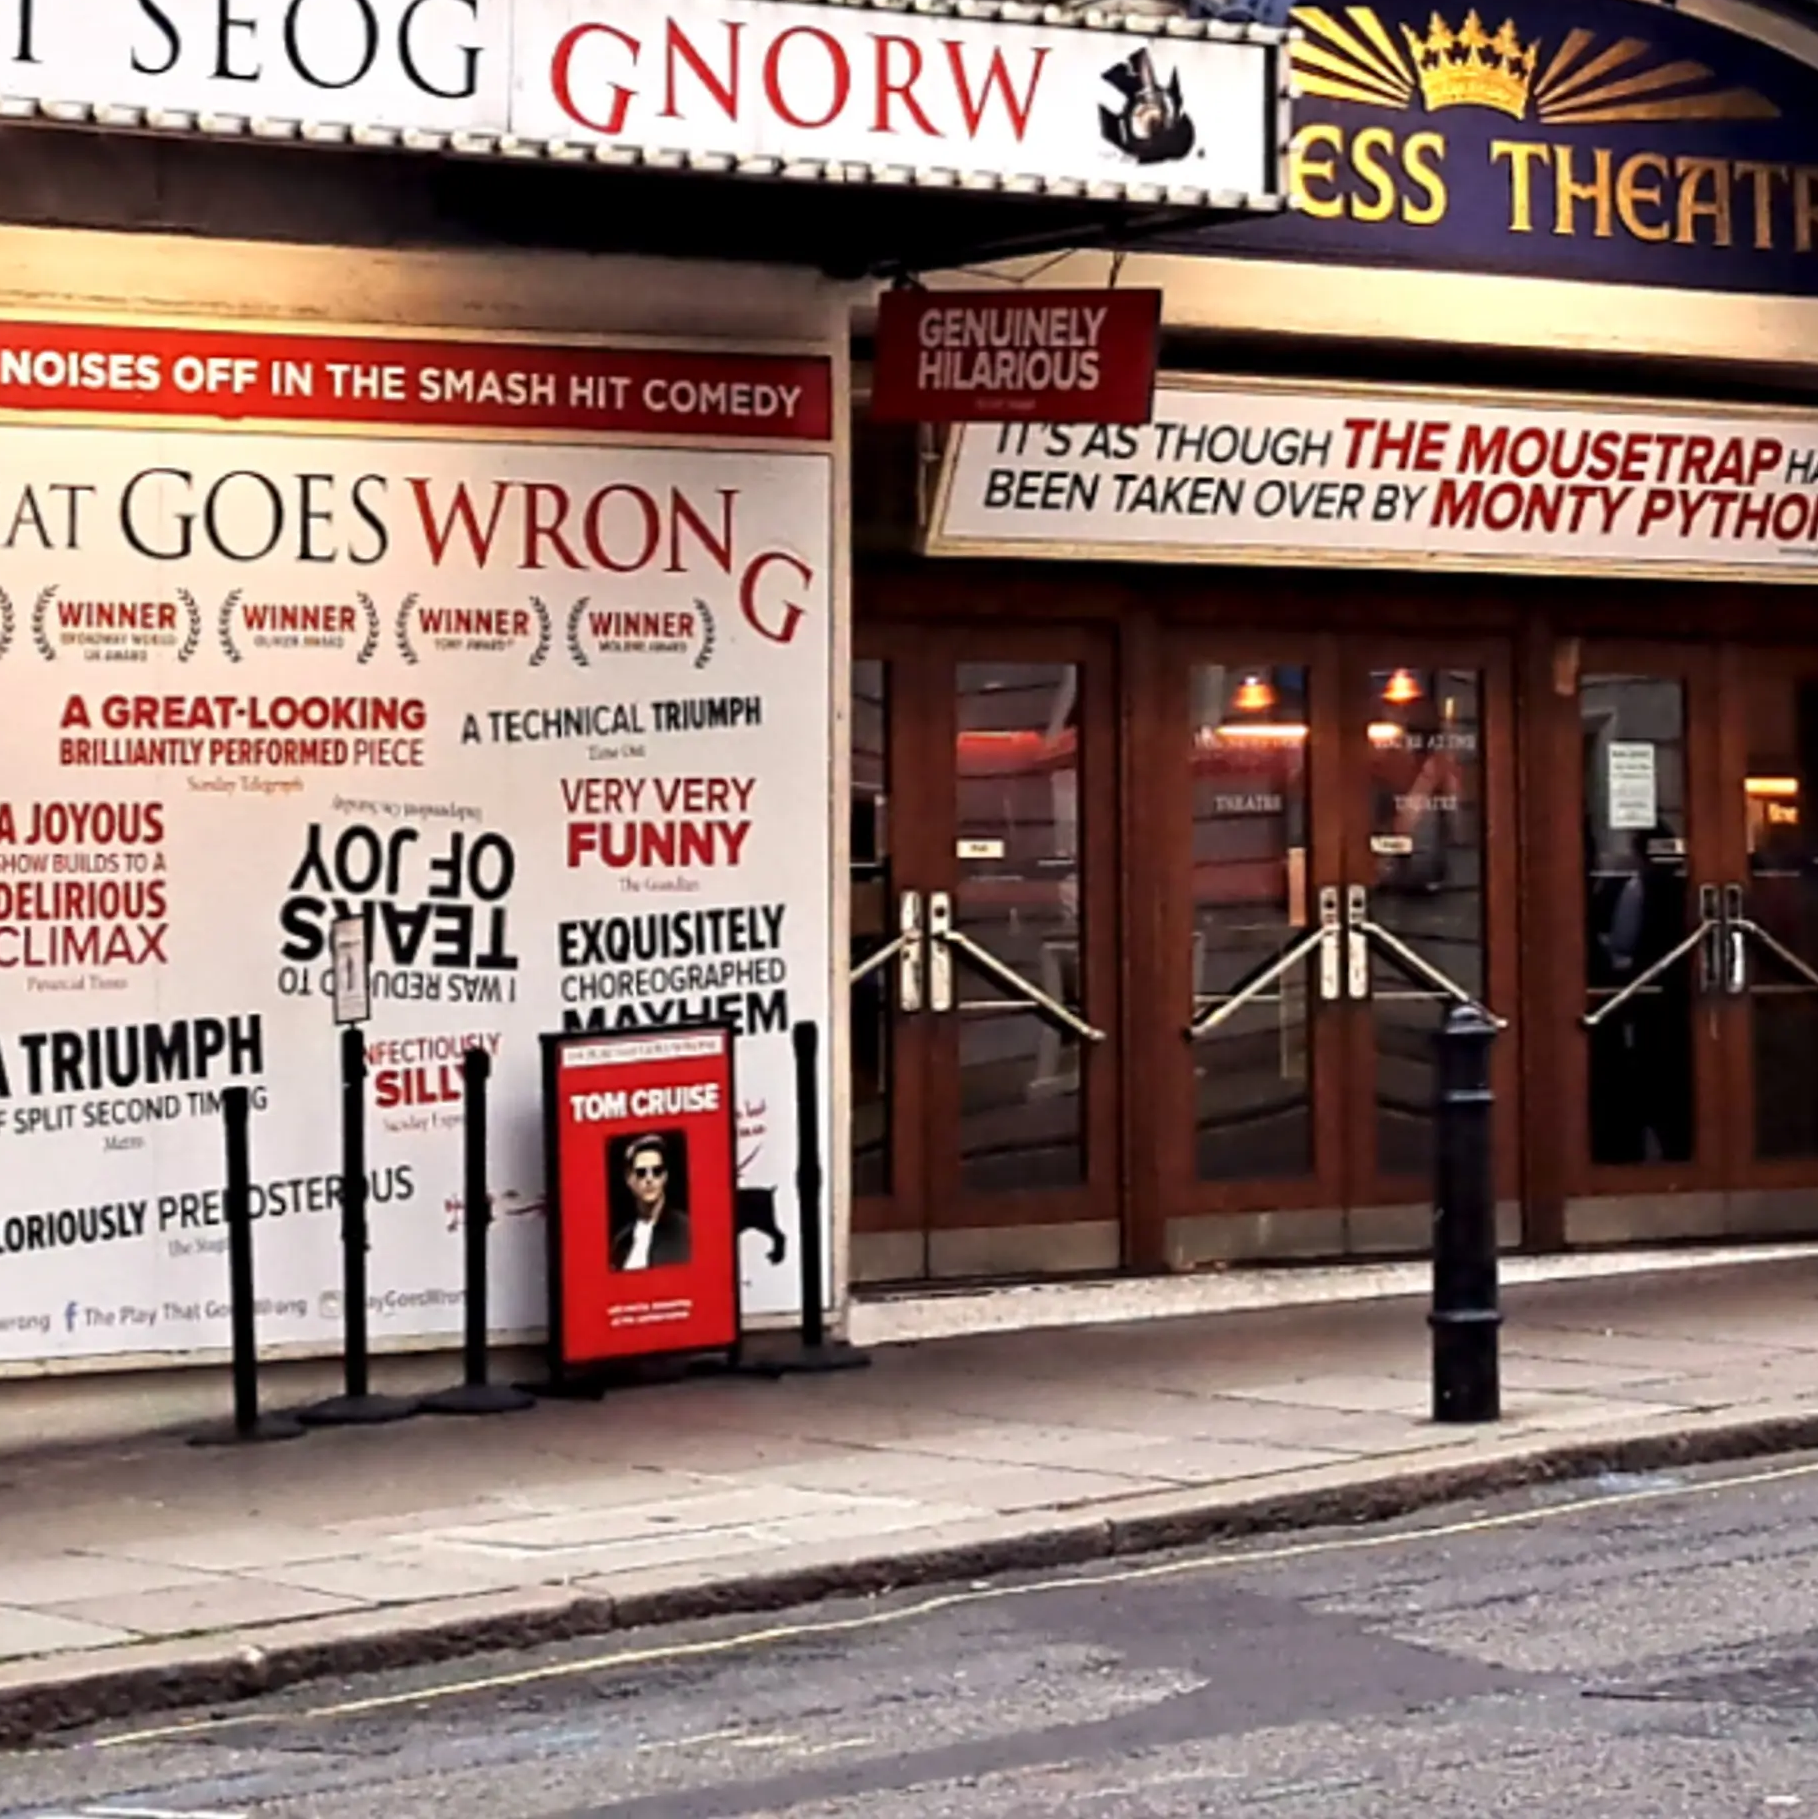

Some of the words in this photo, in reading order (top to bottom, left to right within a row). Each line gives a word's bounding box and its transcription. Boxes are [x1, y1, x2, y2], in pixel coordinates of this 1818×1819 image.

[549, 17, 1051, 146] GNORW
[918, 306, 1107, 355] GENUINELY
[0, 349, 160, 391] NOISES
[173, 357, 257, 392] OFF
[271, 360, 312, 396] IN
[326, 364, 405, 400] THE
[418, 368, 556, 407] SMASH
[569, 375, 631, 410] HIT
[643, 379, 802, 418] COMEDY
[917, 346, 1102, 392] HILARIOUS
[1081, 424, 1140, 460] AS
[1153, 423, 1333, 468] THOUGH
[1342, 418, 1450, 472] THE
[1457, 425, 1783, 487] MOUSETRAP
[983, 468, 1100, 511] BEEN
[1113, 473, 1244, 517] TAKEN
[1253, 479, 1365, 519] OVER
[1371, 484, 1426, 521] BY
[1429, 479, 1634, 535] MONTY
[118, 467, 389, 564] GOES
[406, 477, 814, 644] WRONG
[57, 601, 178, 629] WINNER
[242, 604, 356, 632] WINNER
[418, 608, 529, 637] WINNER
[588, 611, 694, 639] WINNER
[60, 694, 91, 729] A
[102, 695, 426, 731] GREAT-LOOKING
[462, 713, 482, 744] A
[487, 704, 645, 743] TECHNICAL
[651, 695, 762, 733] TRIUMPH
[60, 737, 204, 767] BRILLIANTLY
[209, 738, 348, 767] PERFORMED
[354, 739, 424, 767] PIECE
[560, 777, 647, 814] VERY
[653, 777, 756, 813] VERY
[26, 802, 164, 845] JOYOUS
[566, 819, 752, 869] FUNNY
[52, 854, 119, 872] BUILDS
[125, 854, 147, 872] TO
[152, 853, 166, 871] A
[289, 822, 419, 896] JOY
[429, 831, 516, 902] OF
[559, 904, 786, 967] EXQUISITELY
[278, 966, 313, 996] TO
[448, 973, 502, 1002] WAS
[561, 957, 786, 1002] CHOREOGRAPHED
[562, 989, 789, 1037] MAYHEM
[20, 1014, 264, 1095] TRIUMPH
[14, 1103, 75, 1134] SPLIT
[82, 1094, 181, 1128] SECOND
[186, 1086, 268, 1117] TIMG
[570, 1089, 627, 1124] TOM
[630, 1083, 720, 1117] CRUISE
[158, 1165, 414, 1231] PREOSTERUS
